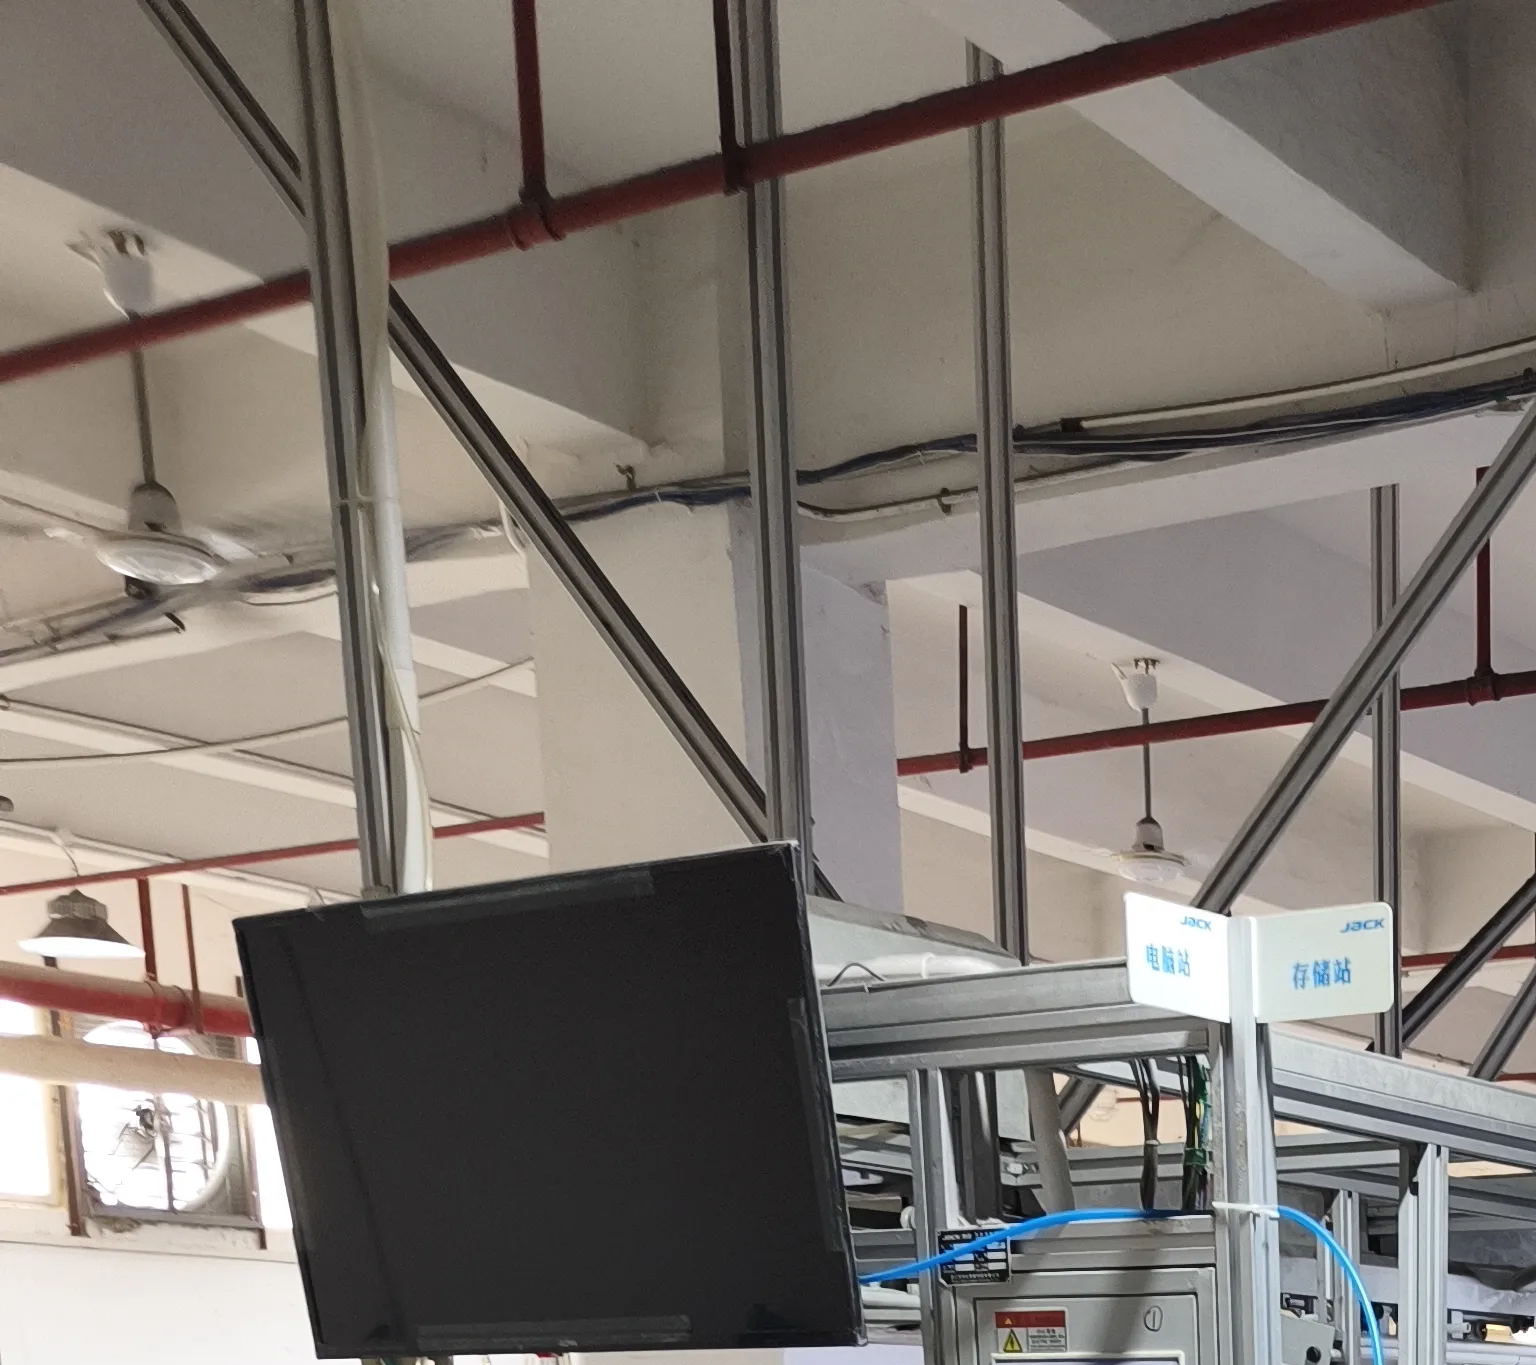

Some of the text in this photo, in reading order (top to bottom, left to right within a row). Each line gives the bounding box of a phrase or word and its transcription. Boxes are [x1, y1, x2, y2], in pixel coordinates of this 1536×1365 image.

[1145, 943, 1191, 978] 电脑站
[1291, 957, 1352, 990] 存储站
